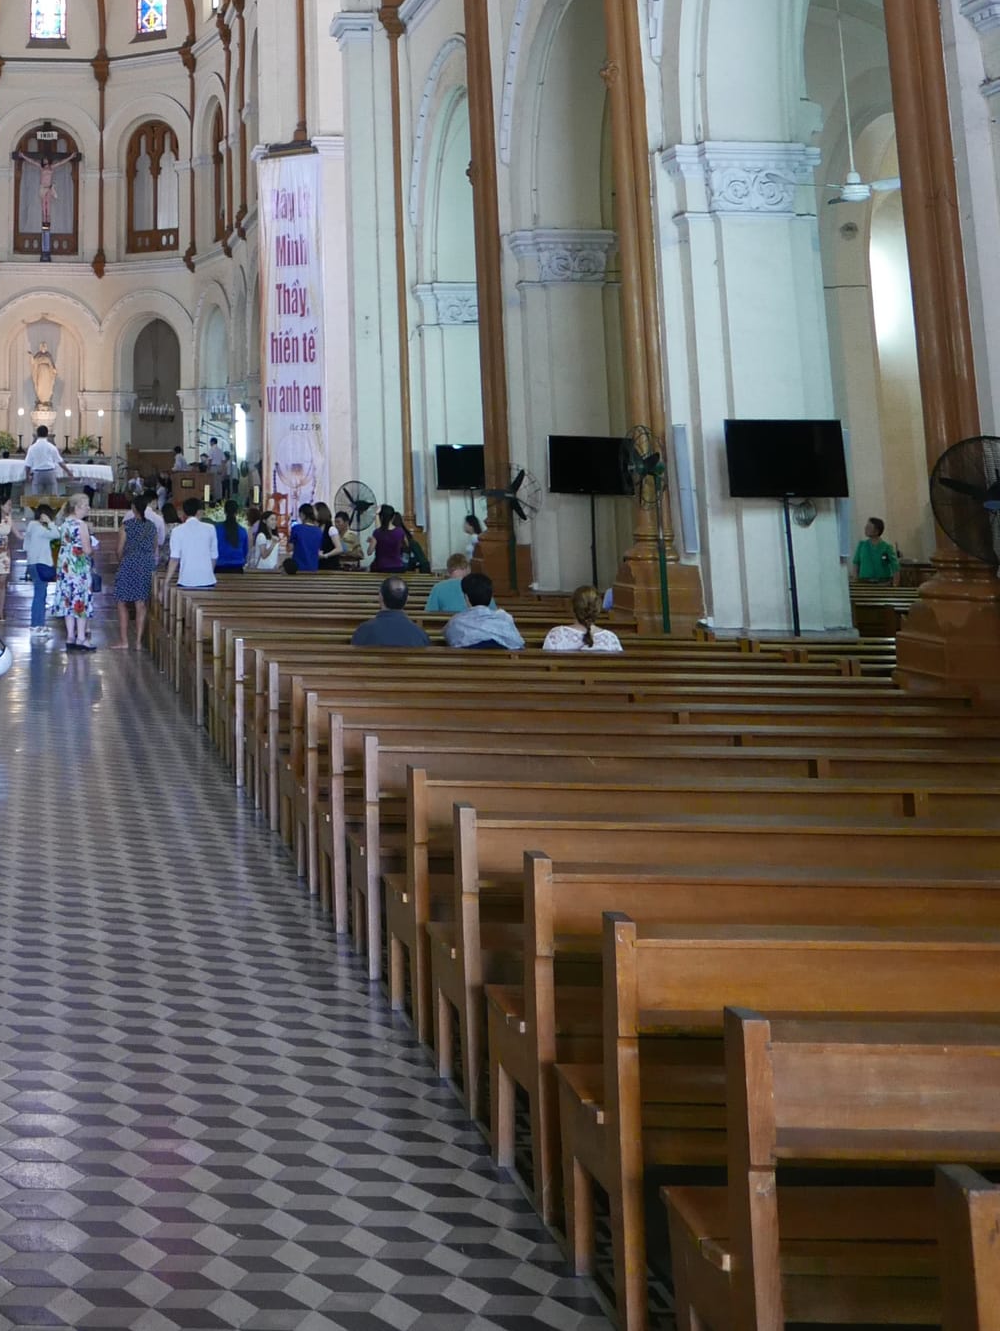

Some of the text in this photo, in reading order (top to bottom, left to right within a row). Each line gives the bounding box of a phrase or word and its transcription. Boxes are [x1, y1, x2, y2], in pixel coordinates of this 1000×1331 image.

[276, 278, 310, 318] Thầy,
[271, 327, 318, 364] hiến tế
[267, 379, 322, 413] vì anh em
